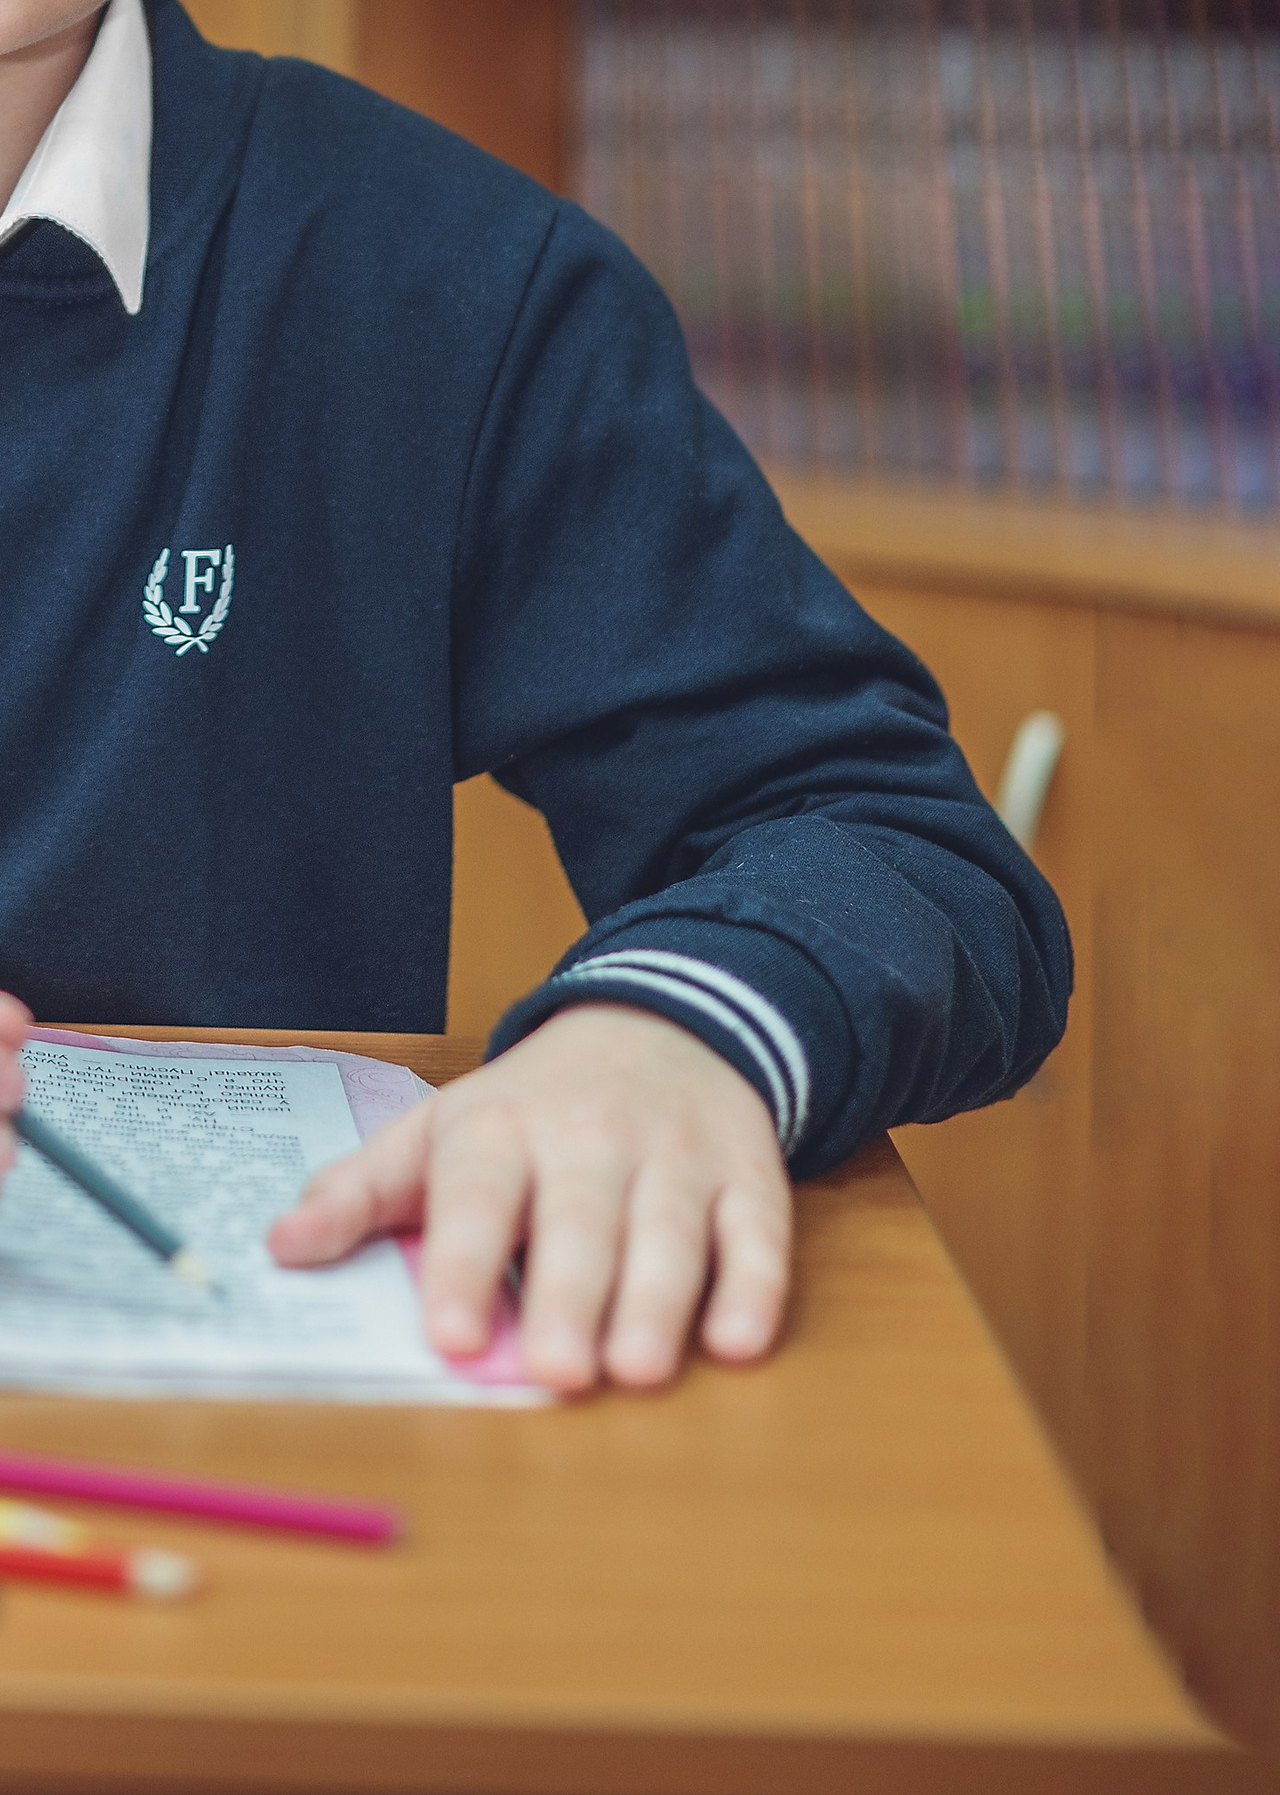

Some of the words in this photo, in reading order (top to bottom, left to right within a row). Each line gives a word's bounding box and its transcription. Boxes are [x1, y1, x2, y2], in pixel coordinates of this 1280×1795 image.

[178, 548, 222, 614] F
[23, 1055, 69, 1068] буду
[86, 1066, 114, 1074] тут
[114, 1062, 194, 1076] Пустить
[47, 1074, 115, 1088] скажет
[55, 1067, 173, 1086] товарищам.
[130, 1071, 181, 1080] вами
[217, 1084, 287, 1092] душка,
[121, 1090, 183, 1101] двери
[199, 1097, 263, 1105] самой
[221, 1091, 289, 1100] Только
